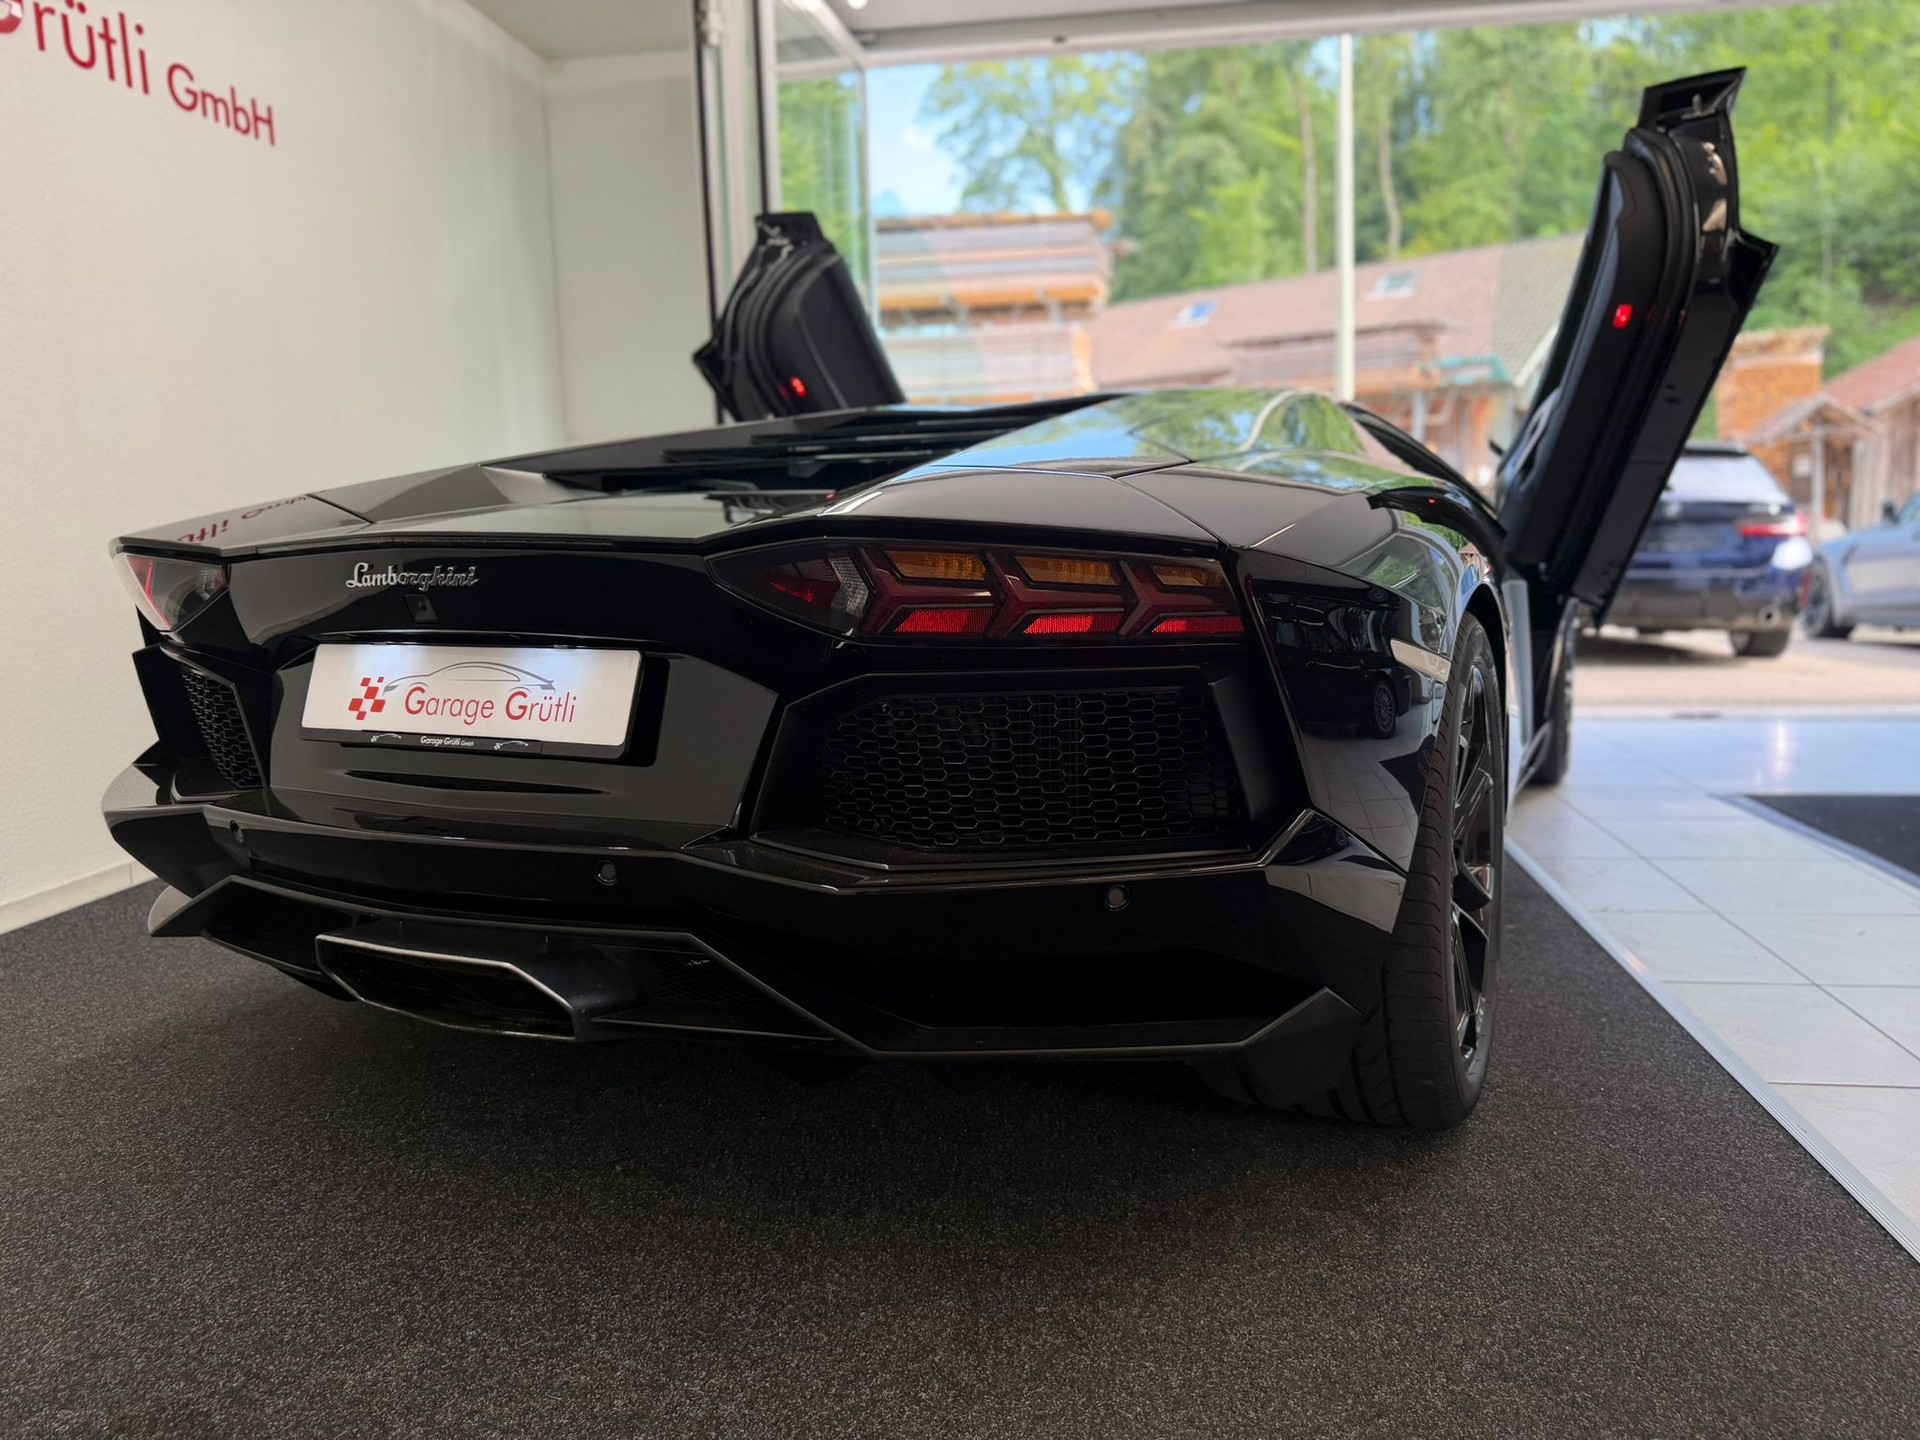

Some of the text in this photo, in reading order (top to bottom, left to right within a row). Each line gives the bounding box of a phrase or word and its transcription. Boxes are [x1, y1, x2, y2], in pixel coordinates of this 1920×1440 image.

[167, 63, 276, 146] GmbH
[345, 562, 479, 592] Lamborghini
[405, 686, 578, 726] Garage Grütli
[420, 735, 443, 747] Garage
